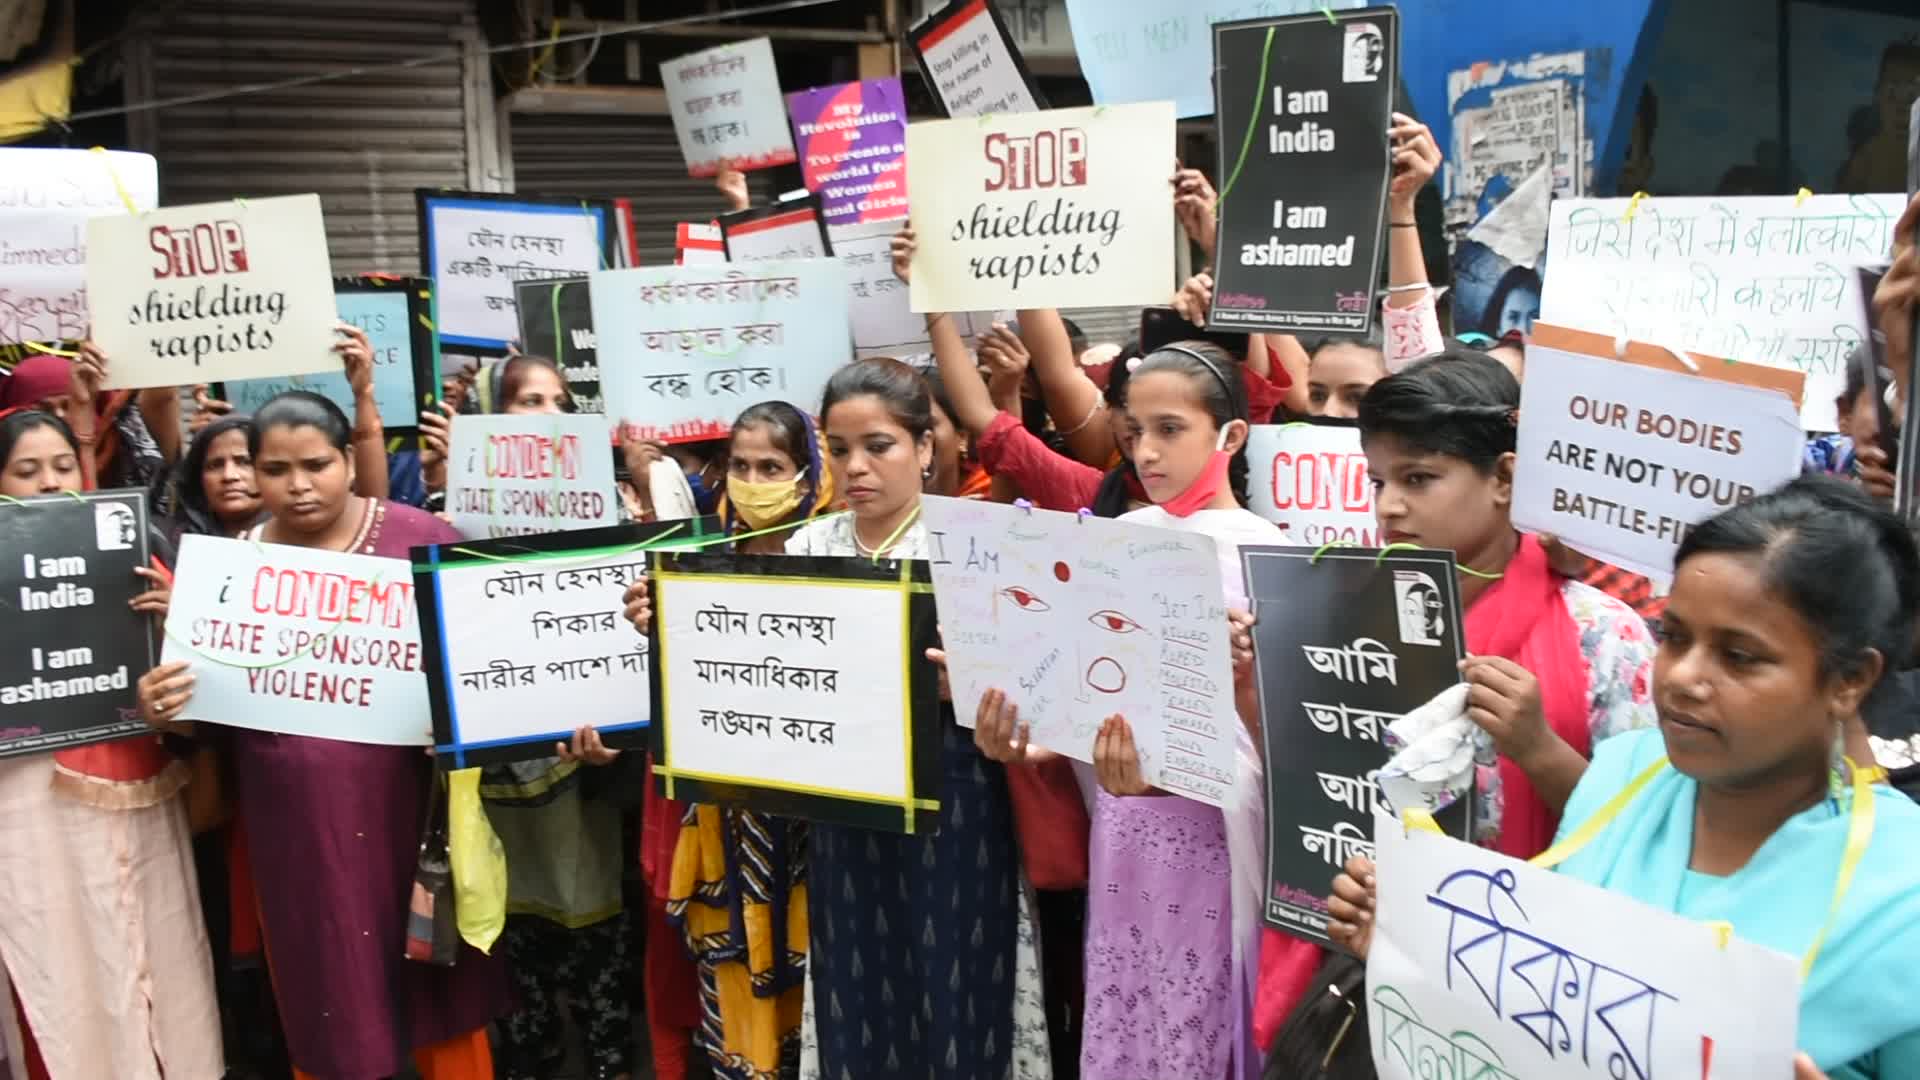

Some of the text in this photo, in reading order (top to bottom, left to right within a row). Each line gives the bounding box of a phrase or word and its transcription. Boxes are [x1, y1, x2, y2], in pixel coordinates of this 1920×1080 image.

[832, 103, 863, 117] My
[1274, 86, 1329, 115] I am
[807, 154, 832, 167] To
[832, 144, 892, 163] create
[1269, 122, 1335, 154] India
[815, 161, 904, 184] world for
[984, 126, 1088, 192] STOP
[821, 195, 908, 218] and Girls
[825, 180, 898, 200] Women
[951, 197, 1125, 247] shielding
[1273, 200, 1327, 229] I am
[1, 224, 87, 265] immedi
[150, 220, 249, 279] STOP
[1241, 235, 1355, 267] ashamed
[968, 243, 1101, 291] rapists
[128, 285, 290, 328] shielding
[149, 323, 275, 365] rapists
[642, 372, 693, 398] বন্ধ
[1568, 394, 1744, 456] OUR BODIES
[466, 432, 583, 481] i CONDEMN
[1545, 439, 1598, 472] ARE
[1603, 452, 1665, 488] NOT
[1271, 451, 1377, 513] COND
[455, 487, 605, 521] STATE SPONSORED
[23, 554, 88, 579] I am
[930, 530, 1001, 575] I AM
[19, 583, 95, 612] India
[217, 575, 234, 605] i
[484, 569, 545, 600] যৌন
[531, 609, 617, 640] শিকার
[694, 602, 836, 646] যৌন হেনস্থা
[31, 647, 93, 671] I am
[191, 617, 427, 673] STATE SPONSORE
[1301, 636, 1399, 686] আমি
[0, 665, 130, 706] ashamed
[459, 642, 650, 693] নারীর পাশে দাঁ
[692, 655, 840, 693] মানবাধিকার
[247, 667, 375, 708] VIOLENCE
[779, 716, 836, 745] করে
